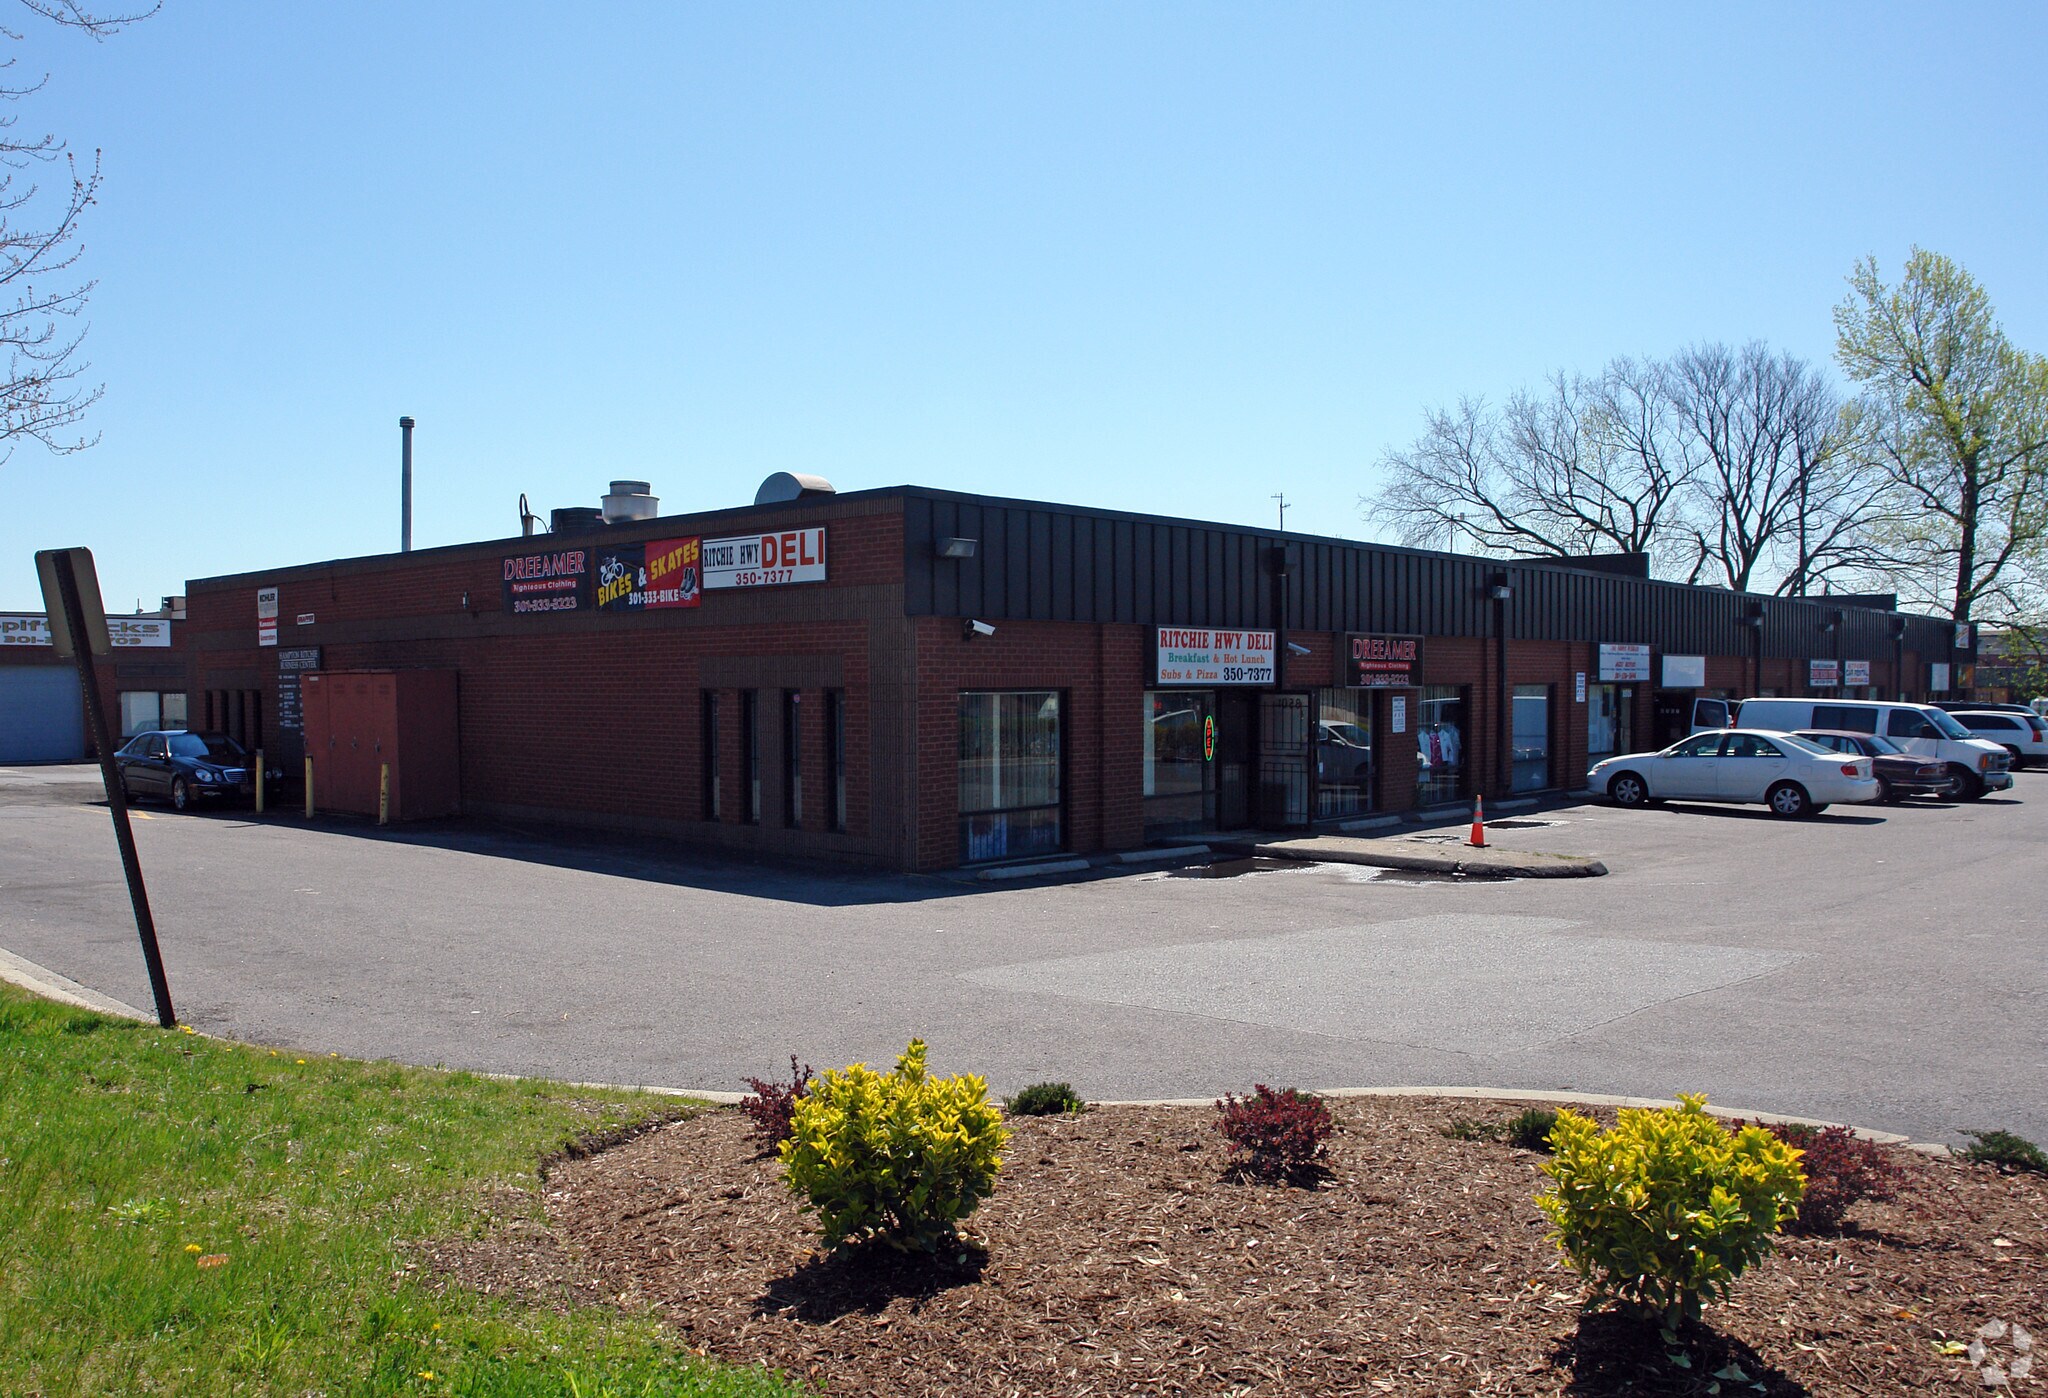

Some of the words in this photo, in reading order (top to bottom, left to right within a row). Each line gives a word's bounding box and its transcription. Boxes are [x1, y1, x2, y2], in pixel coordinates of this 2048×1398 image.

[650, 539, 699, 580] SKATES
[704, 546, 734, 567] RITCHIE
[740, 543, 759, 564] HWY
[761, 530, 824, 569] DELI
[504, 550, 585, 581] DREEAMER
[513, 583, 546, 593] Righteous
[547, 580, 577, 588] Clothing
[597, 573, 632, 606] BIKES
[638, 567, 647, 587] &
[736, 569, 793, 585] 350-7377
[0, 619, 50, 633] piff
[1160, 630, 1209, 649] RITCHIE
[1214, 632, 1242, 649] HWY
[1247, 633, 1272, 650] DELI
[1353, 639, 1416, 660] DREEAMER
[1168, 652, 1209, 663] Breakfast
[1213, 654, 1219, 663] &
[1223, 653, 1238, 663] Hot
[1241, 654, 1265, 663] Lunch
[1161, 669, 1181, 679] Subs
[1186, 669, 1192, 679] &
[1196, 669, 1218, 679] Pizza
[1223, 667, 1272, 681] 350-7377
